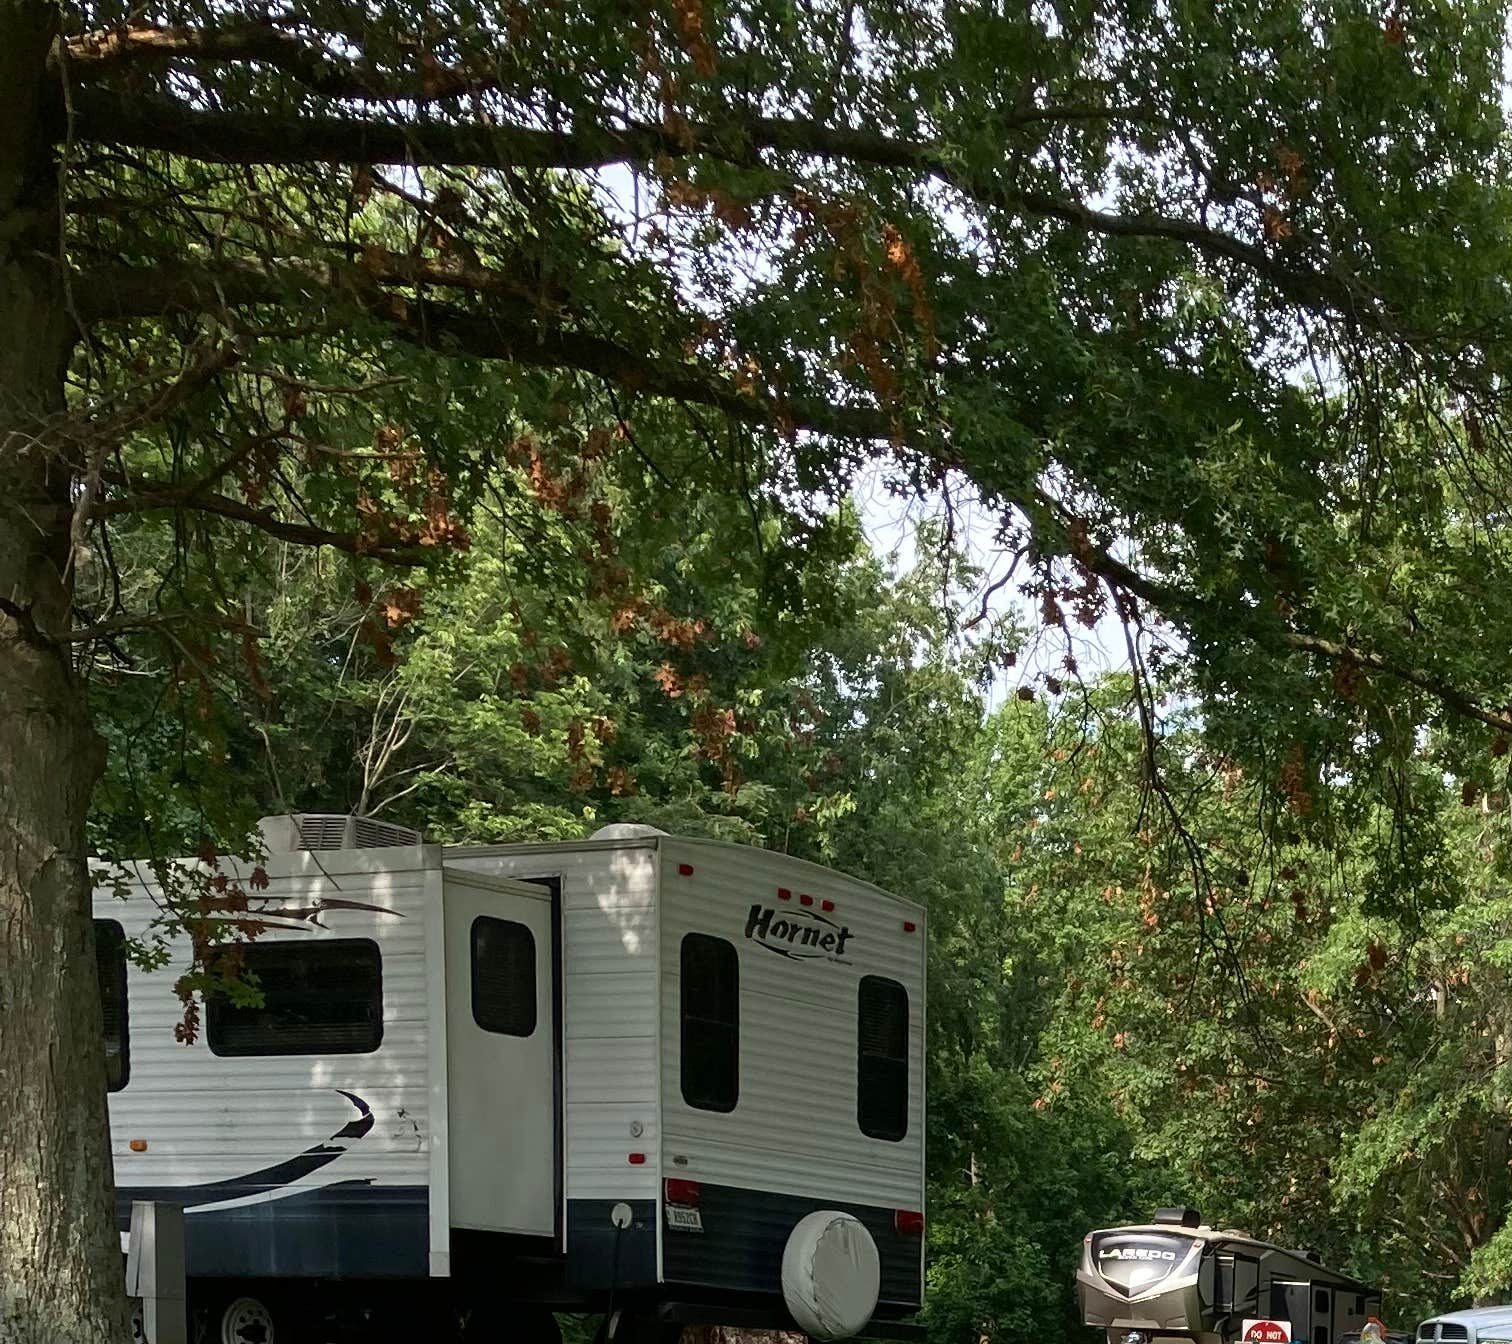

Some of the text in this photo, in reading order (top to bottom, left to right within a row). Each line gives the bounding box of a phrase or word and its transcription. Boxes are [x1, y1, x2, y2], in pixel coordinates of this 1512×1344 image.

[745, 904, 855, 955] Hornet
[1099, 1248, 1176, 1261] LAREDO
[1250, 1329, 1282, 1340] DO NOT
